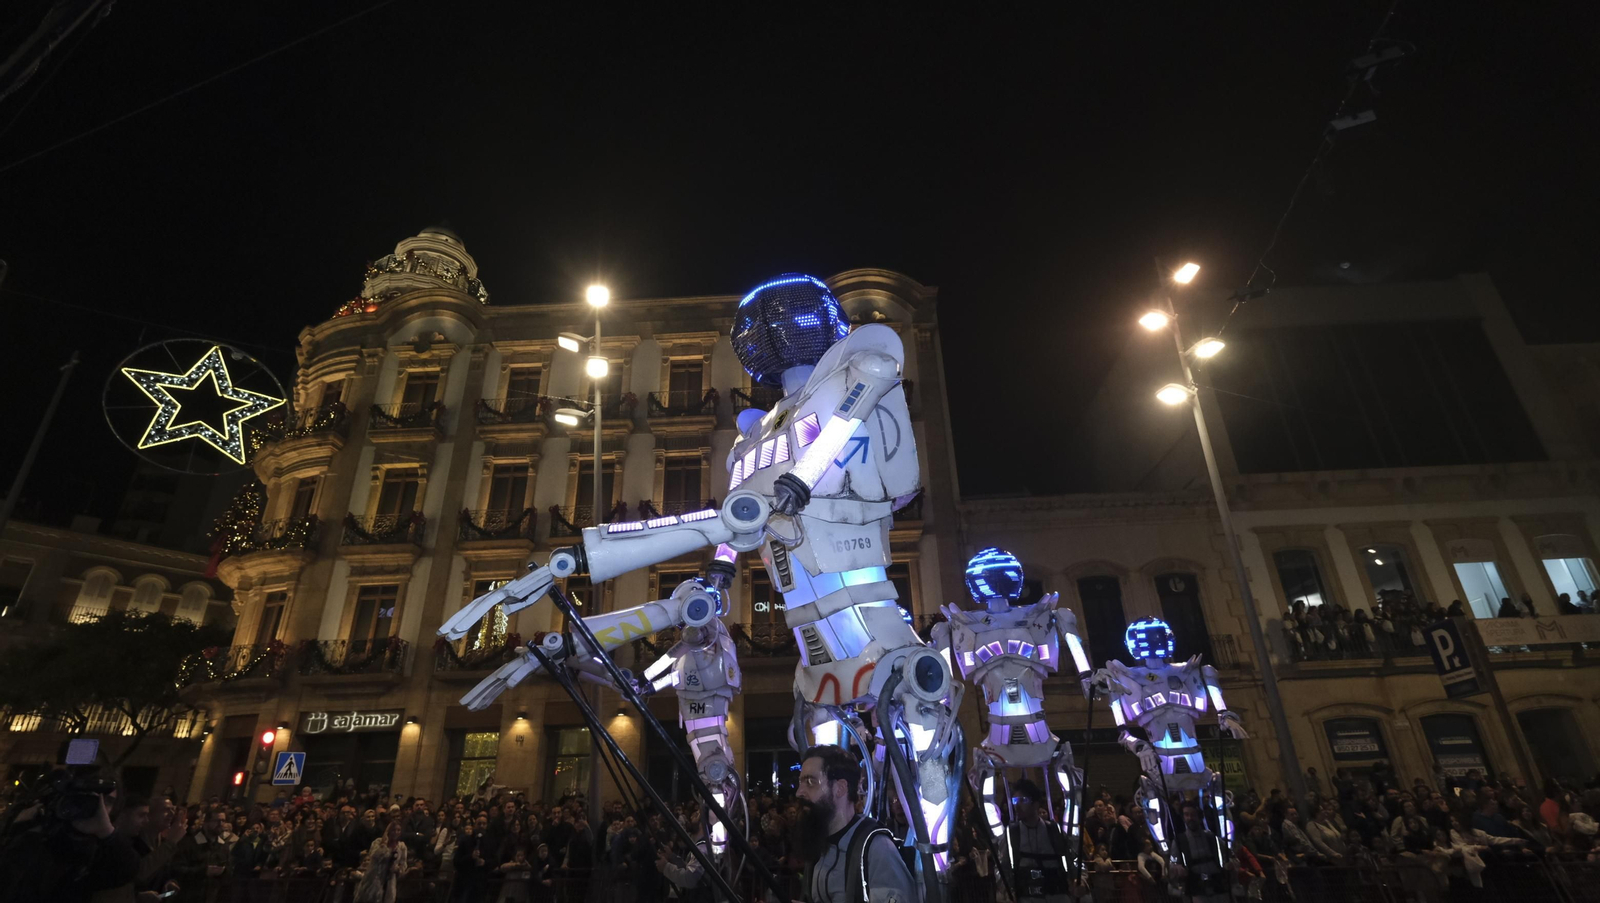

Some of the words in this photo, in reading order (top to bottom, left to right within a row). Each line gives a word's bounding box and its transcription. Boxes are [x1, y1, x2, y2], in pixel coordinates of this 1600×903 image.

[1431, 628, 1455, 671] P
[689, 702, 705, 714] RM
[331, 711, 400, 732] cajamar
